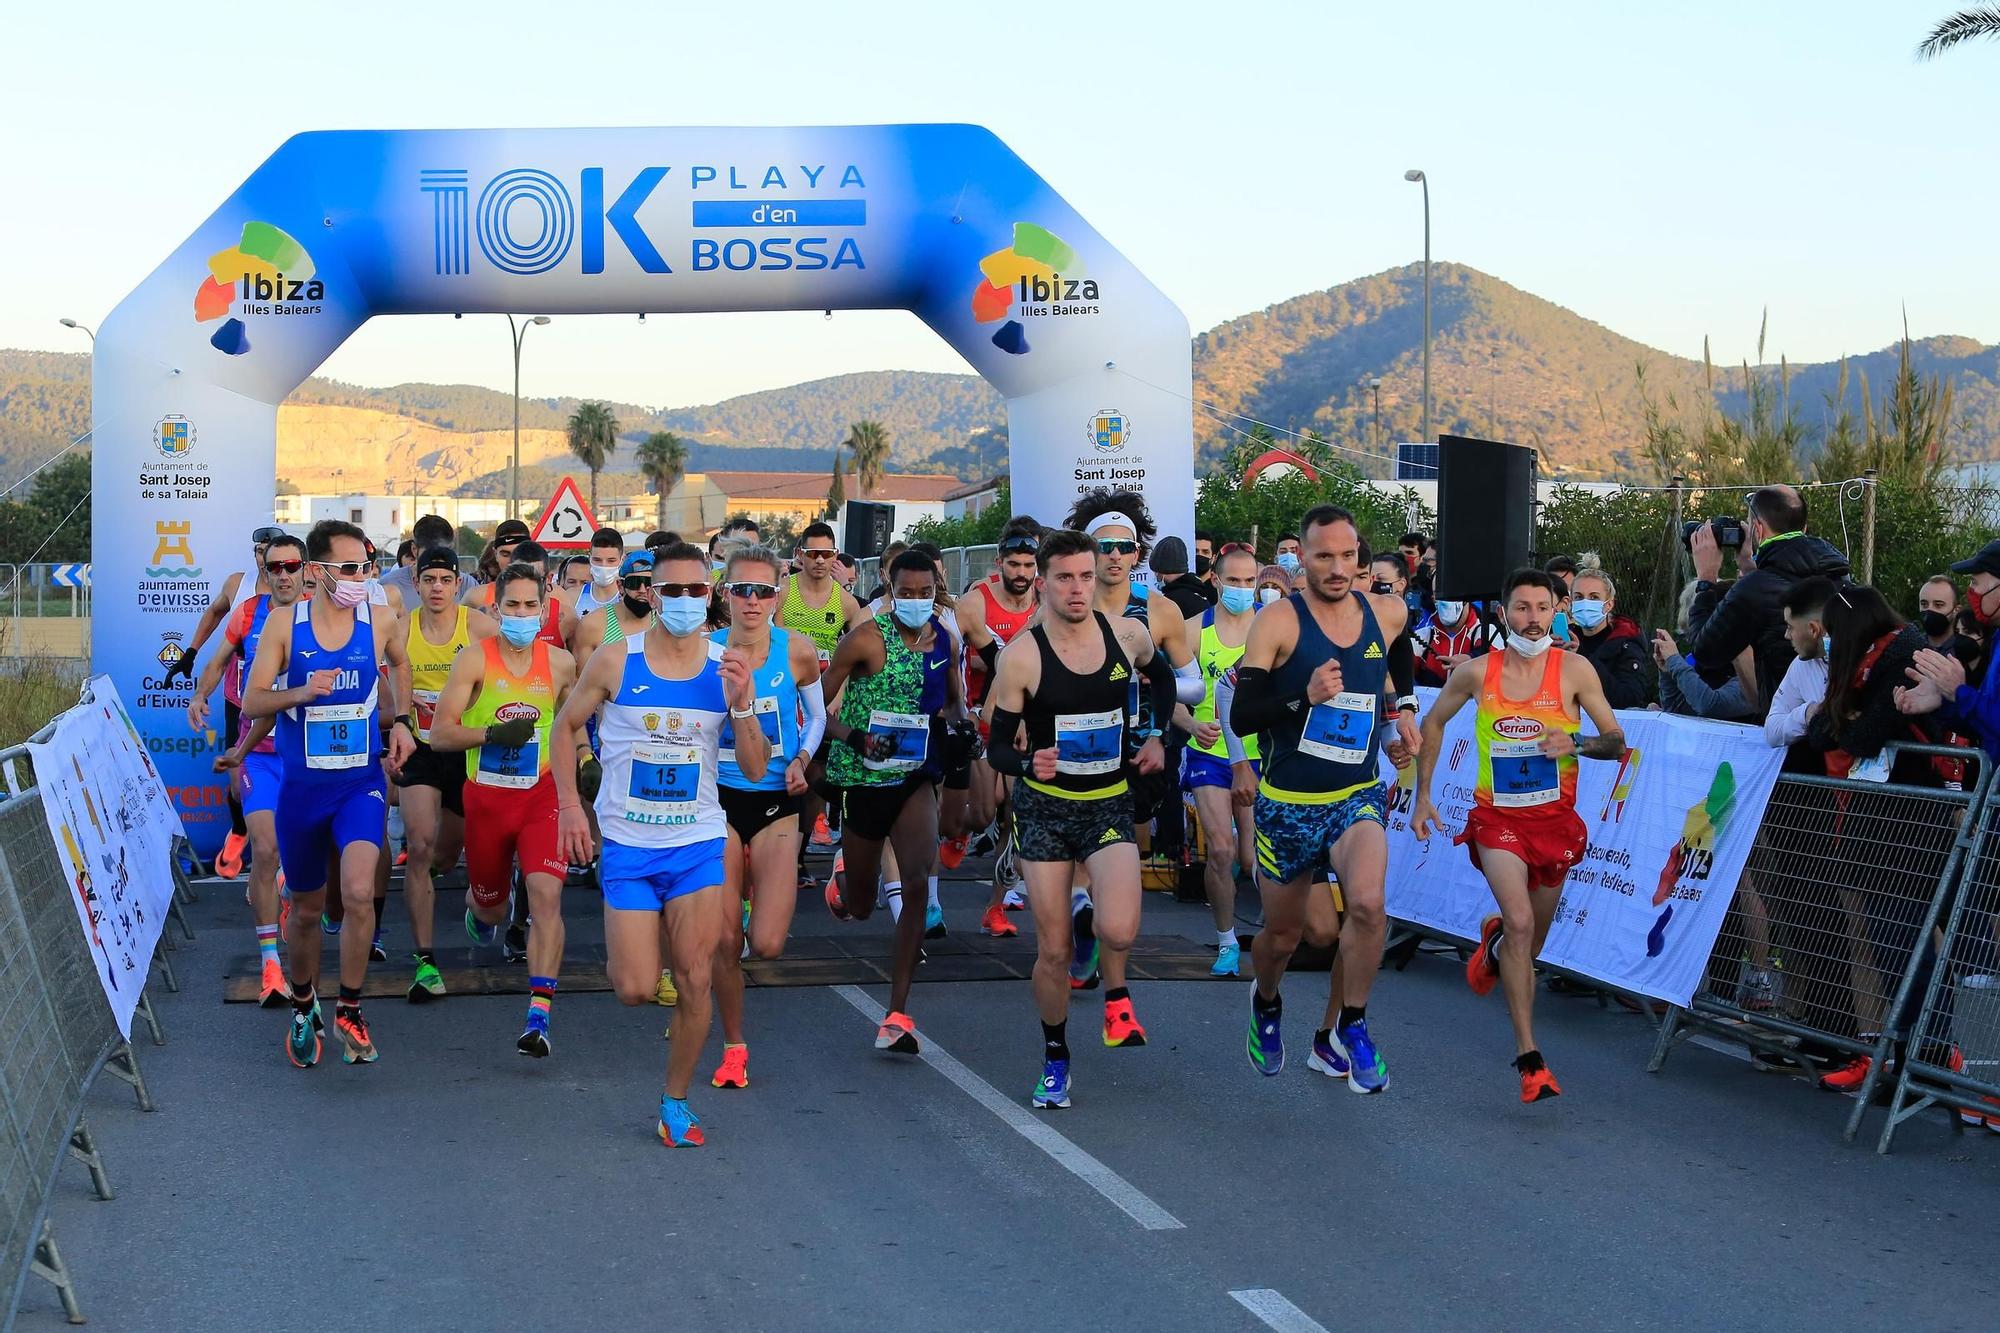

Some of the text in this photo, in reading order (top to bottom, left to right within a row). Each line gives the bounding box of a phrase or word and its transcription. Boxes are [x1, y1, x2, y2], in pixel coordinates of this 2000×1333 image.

[691, 165, 866, 189] PLAYA
[751, 203, 797, 223] d'en
[421, 167, 672, 275] 10K
[691, 237, 866, 271] BOSSA
[243, 272, 324, 301] Ibiza
[1020, 273, 1099, 302] Ibiza
[243, 304, 321, 315] Illes Balears
[1021, 305, 1099, 316] Illes Balears
[141, 462, 209, 472] Ajuntament de
[1076, 456, 1143, 467] Ajuntament de
[139, 474, 211, 487] Sant Josep
[1074, 467, 1145, 480] Sant Josep
[142, 489, 208, 499] de sa Talaia
[1077, 484, 1091, 493] de
[423, 663, 452, 672] KILOMET
[1109, 671, 1129, 681] adidas
[142, 676, 198, 691] Consel
[137, 694, 208, 708] d'Eivis
[499, 708, 537, 720] Serrano
[1338, 713, 1350, 730] 3
[1498, 721, 1541, 734] Serrano
[329, 723, 348, 741] 18
[1087, 733, 1095, 749] 1
[1519, 760, 1529, 777] 4
[656, 767, 677, 785] 15
